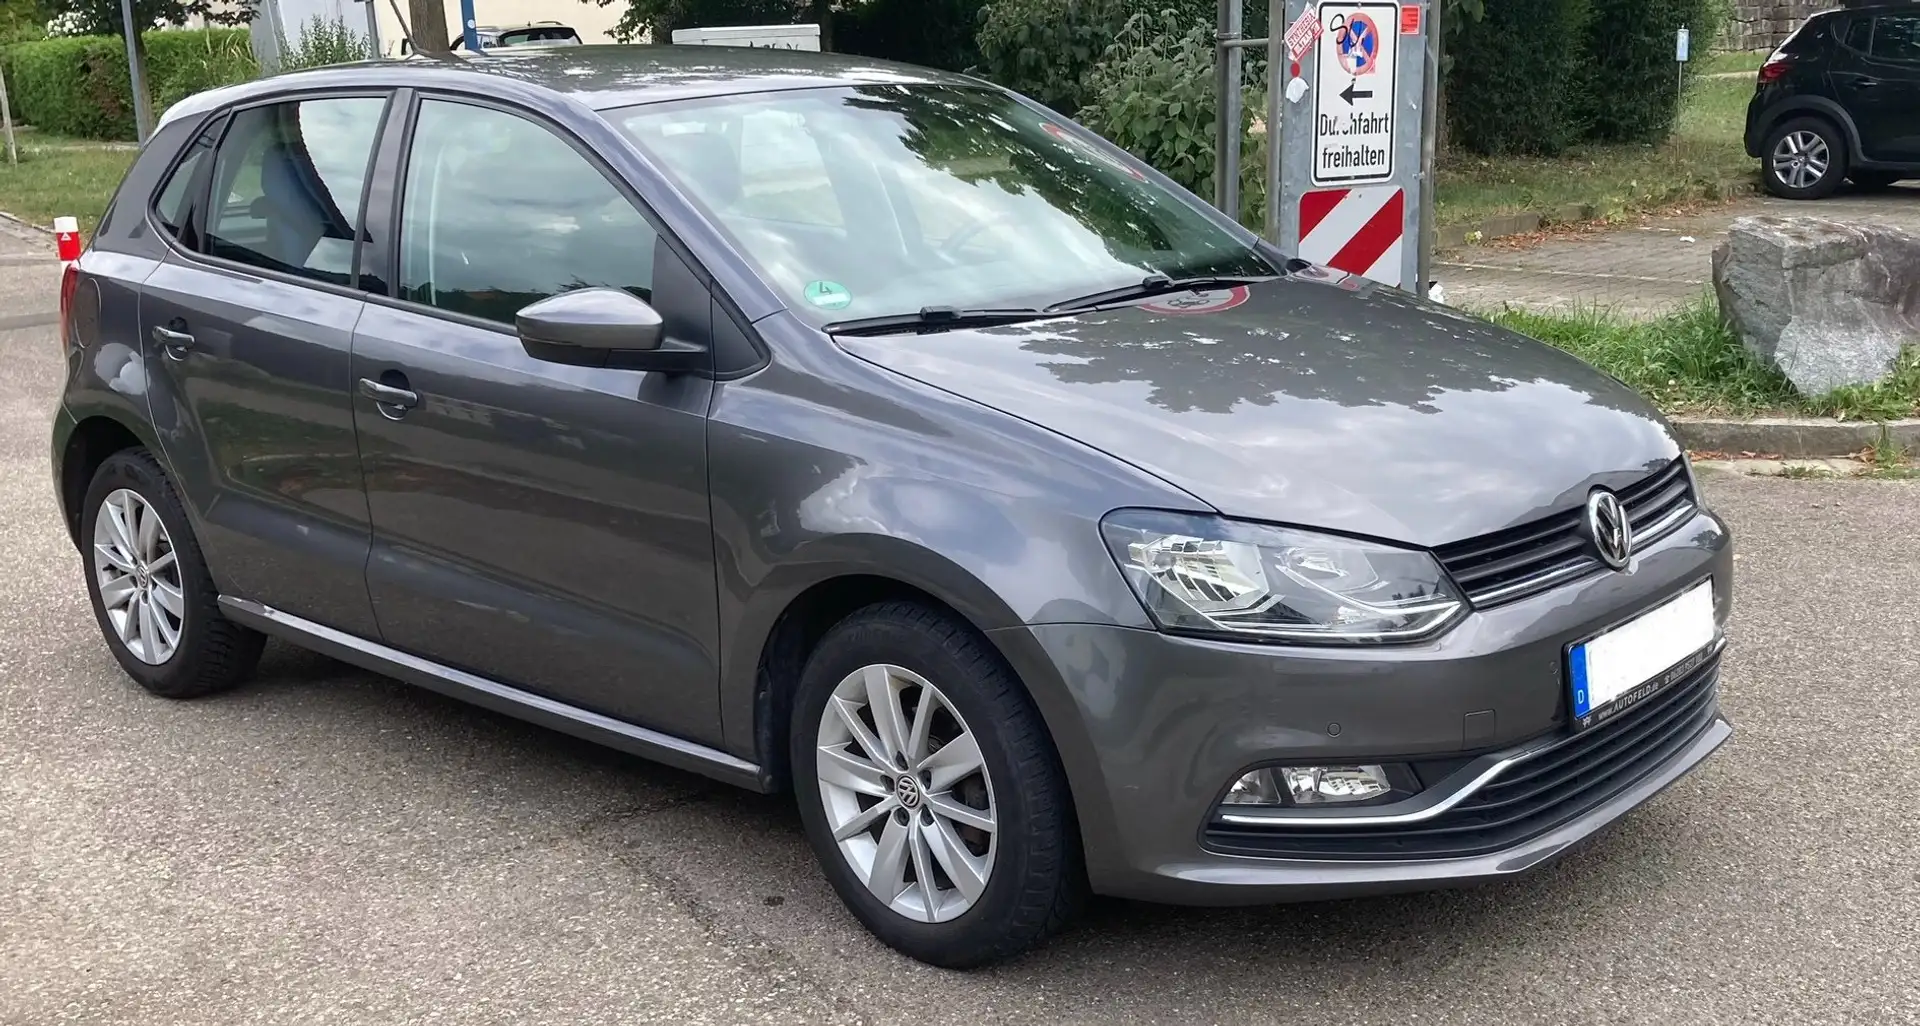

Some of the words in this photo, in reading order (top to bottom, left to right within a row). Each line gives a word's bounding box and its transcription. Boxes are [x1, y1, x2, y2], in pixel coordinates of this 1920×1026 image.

[1320, 112, 1389, 136] Duhfahrt
[1322, 144, 1385, 169] freihalten
[1577, 689, 1585, 705] D
